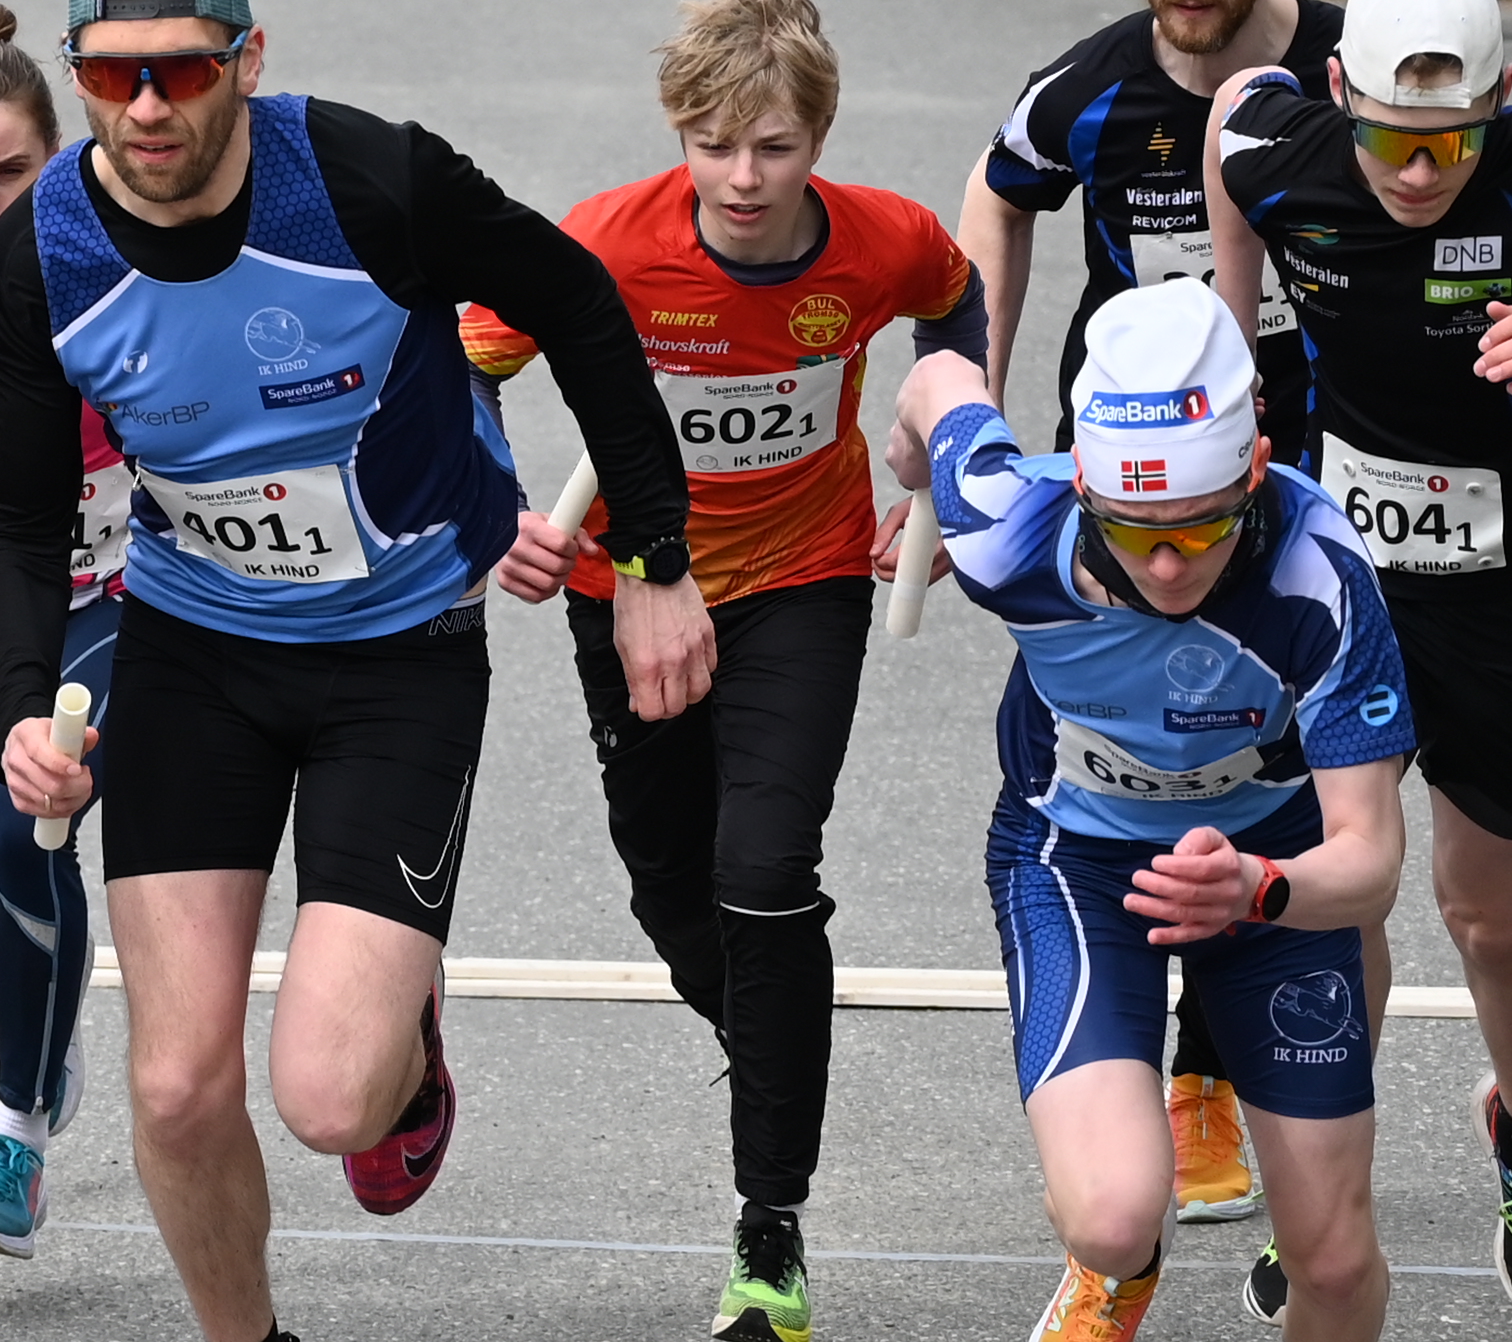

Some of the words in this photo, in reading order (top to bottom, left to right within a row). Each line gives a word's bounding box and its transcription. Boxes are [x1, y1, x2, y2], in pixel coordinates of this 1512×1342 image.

[1132, 213, 1197, 229] REVICOM
[1442, 243, 1495, 265] DNB
[1290, 281, 1307, 305] EY
[1430, 284, 1474, 299] BRIO
[806, 299, 836, 310] BUL
[650, 310, 719, 328] TRIMTEX
[1425, 325, 1464, 339] Toyota
[258, 365, 272, 376] IK
[274, 358, 309, 374] HIND
[267, 378, 336, 401] SpareBank
[704, 382, 774, 396] SpareBank
[121, 401, 212, 427] AkerBP
[1086, 398, 1182, 424] SpareBank
[733, 455, 752, 467] IK
[758, 446, 803, 465] HIND
[1360, 462, 1425, 484] SpareBank
[184, 485, 261, 503] SpareBank
[244, 563, 267, 576] IK
[271, 563, 321, 578] HIND
[1389, 559, 1408, 571] IK
[1415, 560, 1462, 572] HIND
[1168, 690, 1181, 702] IK
[1171, 712, 1240, 725] SpareBank
[1273, 1047, 1292, 1062] IK
[1295, 1047, 1348, 1064] HIND
